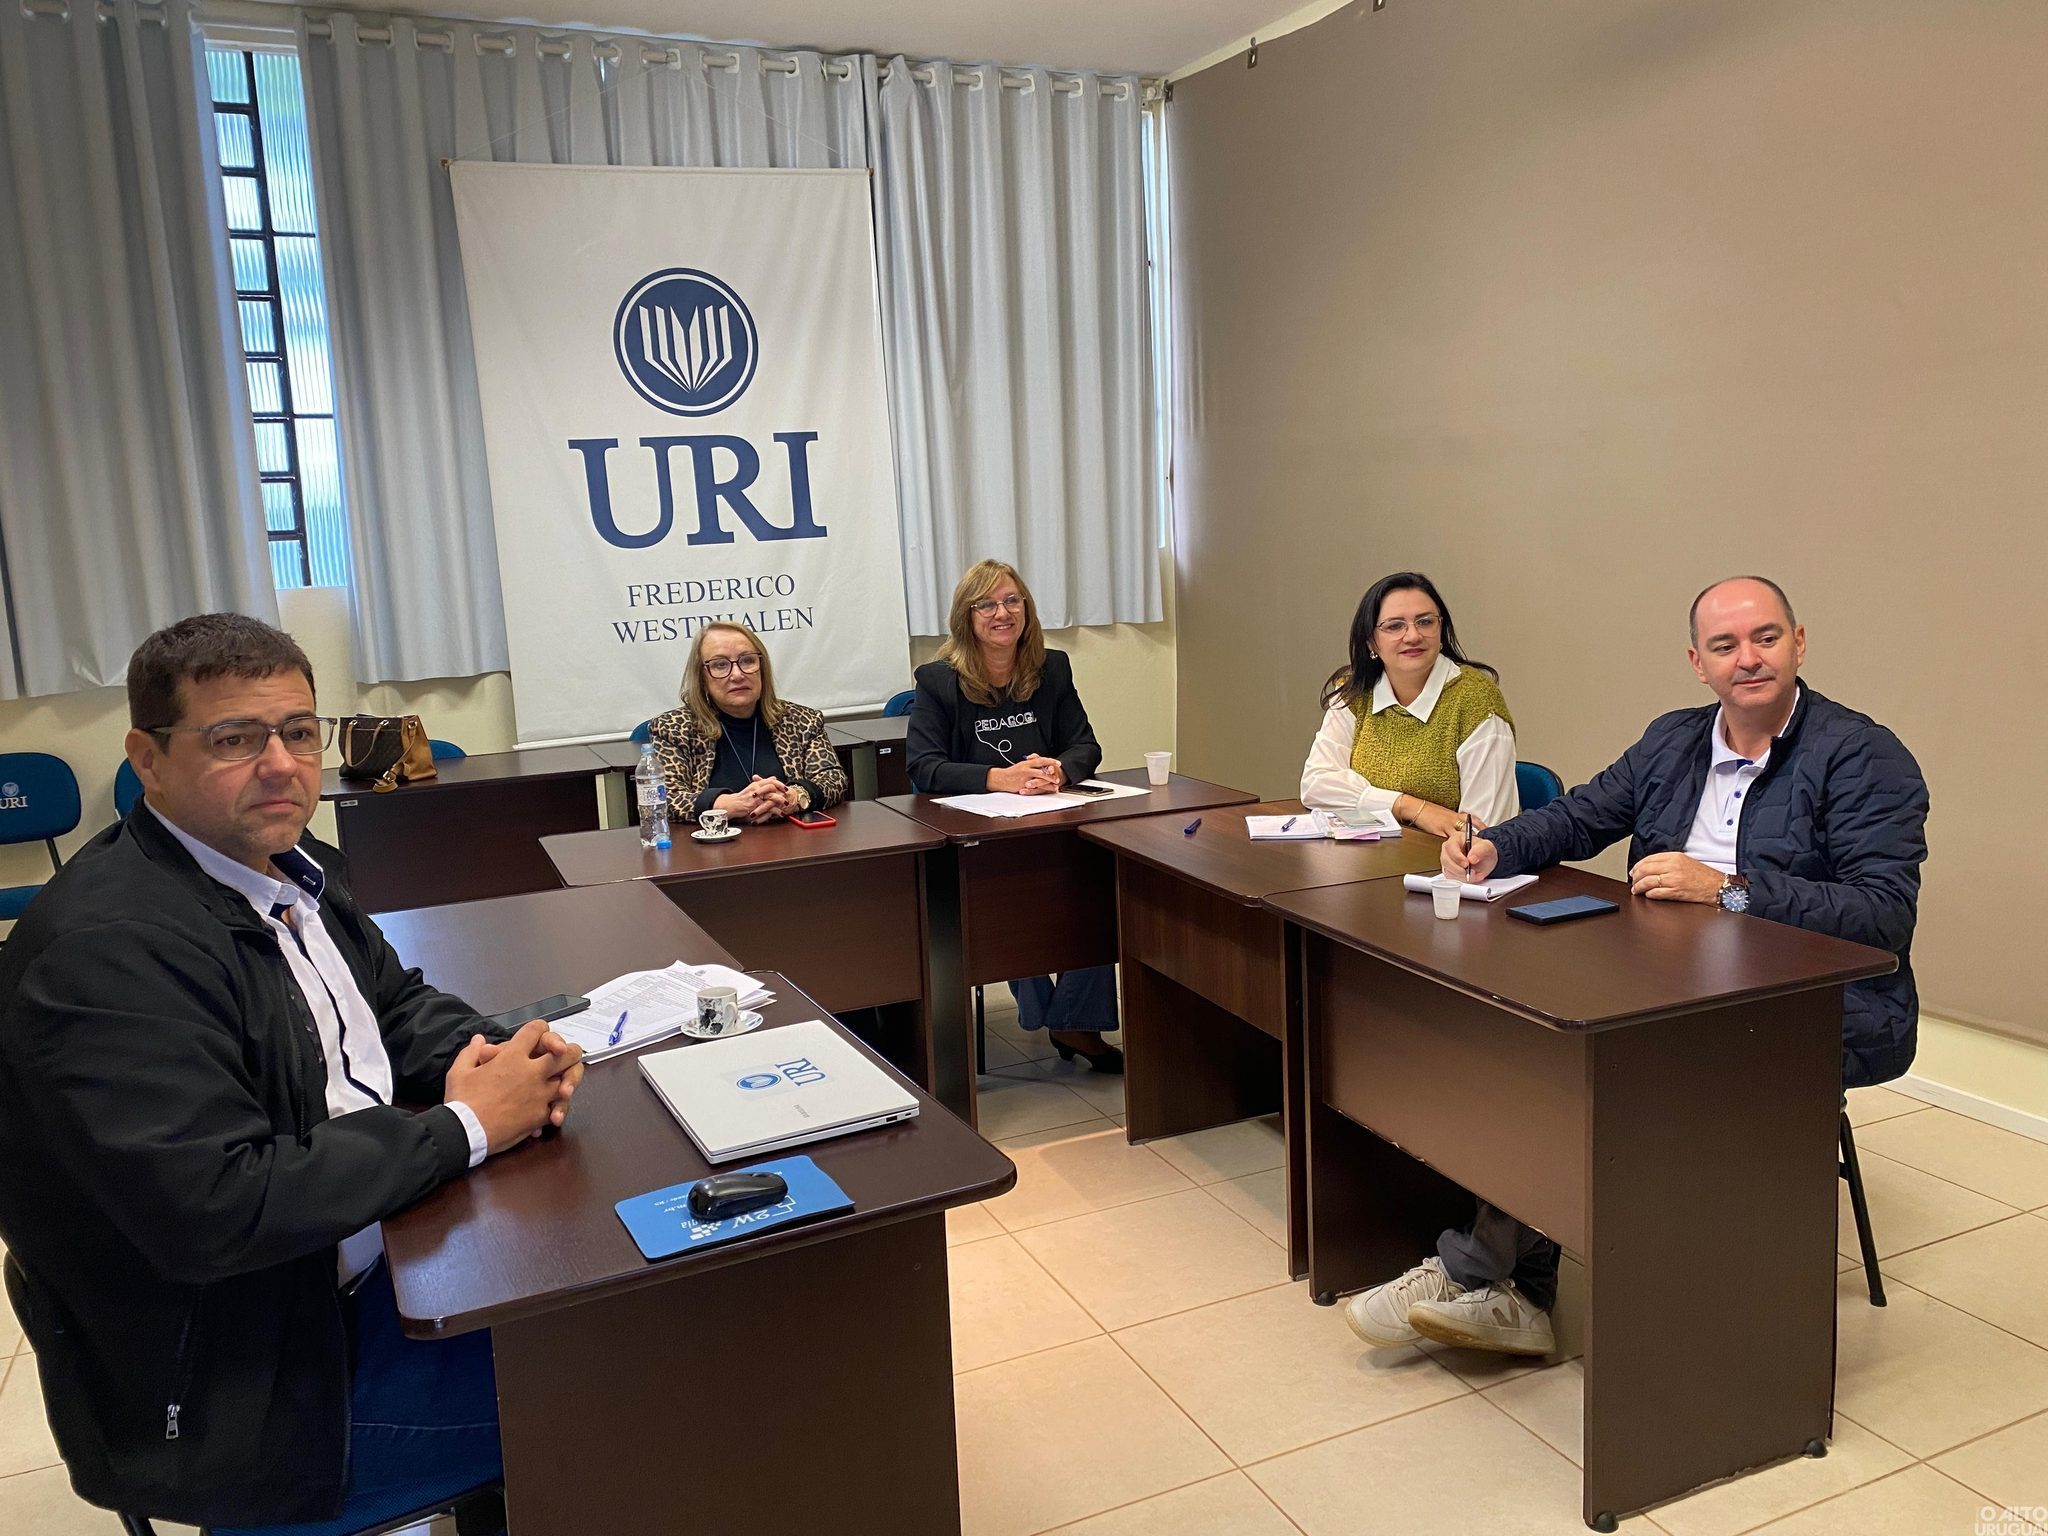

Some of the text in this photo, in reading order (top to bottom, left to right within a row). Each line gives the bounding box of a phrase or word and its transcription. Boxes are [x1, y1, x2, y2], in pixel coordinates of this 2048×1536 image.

[568, 431, 828, 549] URI
[626, 574, 795, 607] FREDERICO
[0, 796, 28, 809] URI
[775, 1058, 826, 1086] URI
[732, 1209, 770, 1229] 2W
